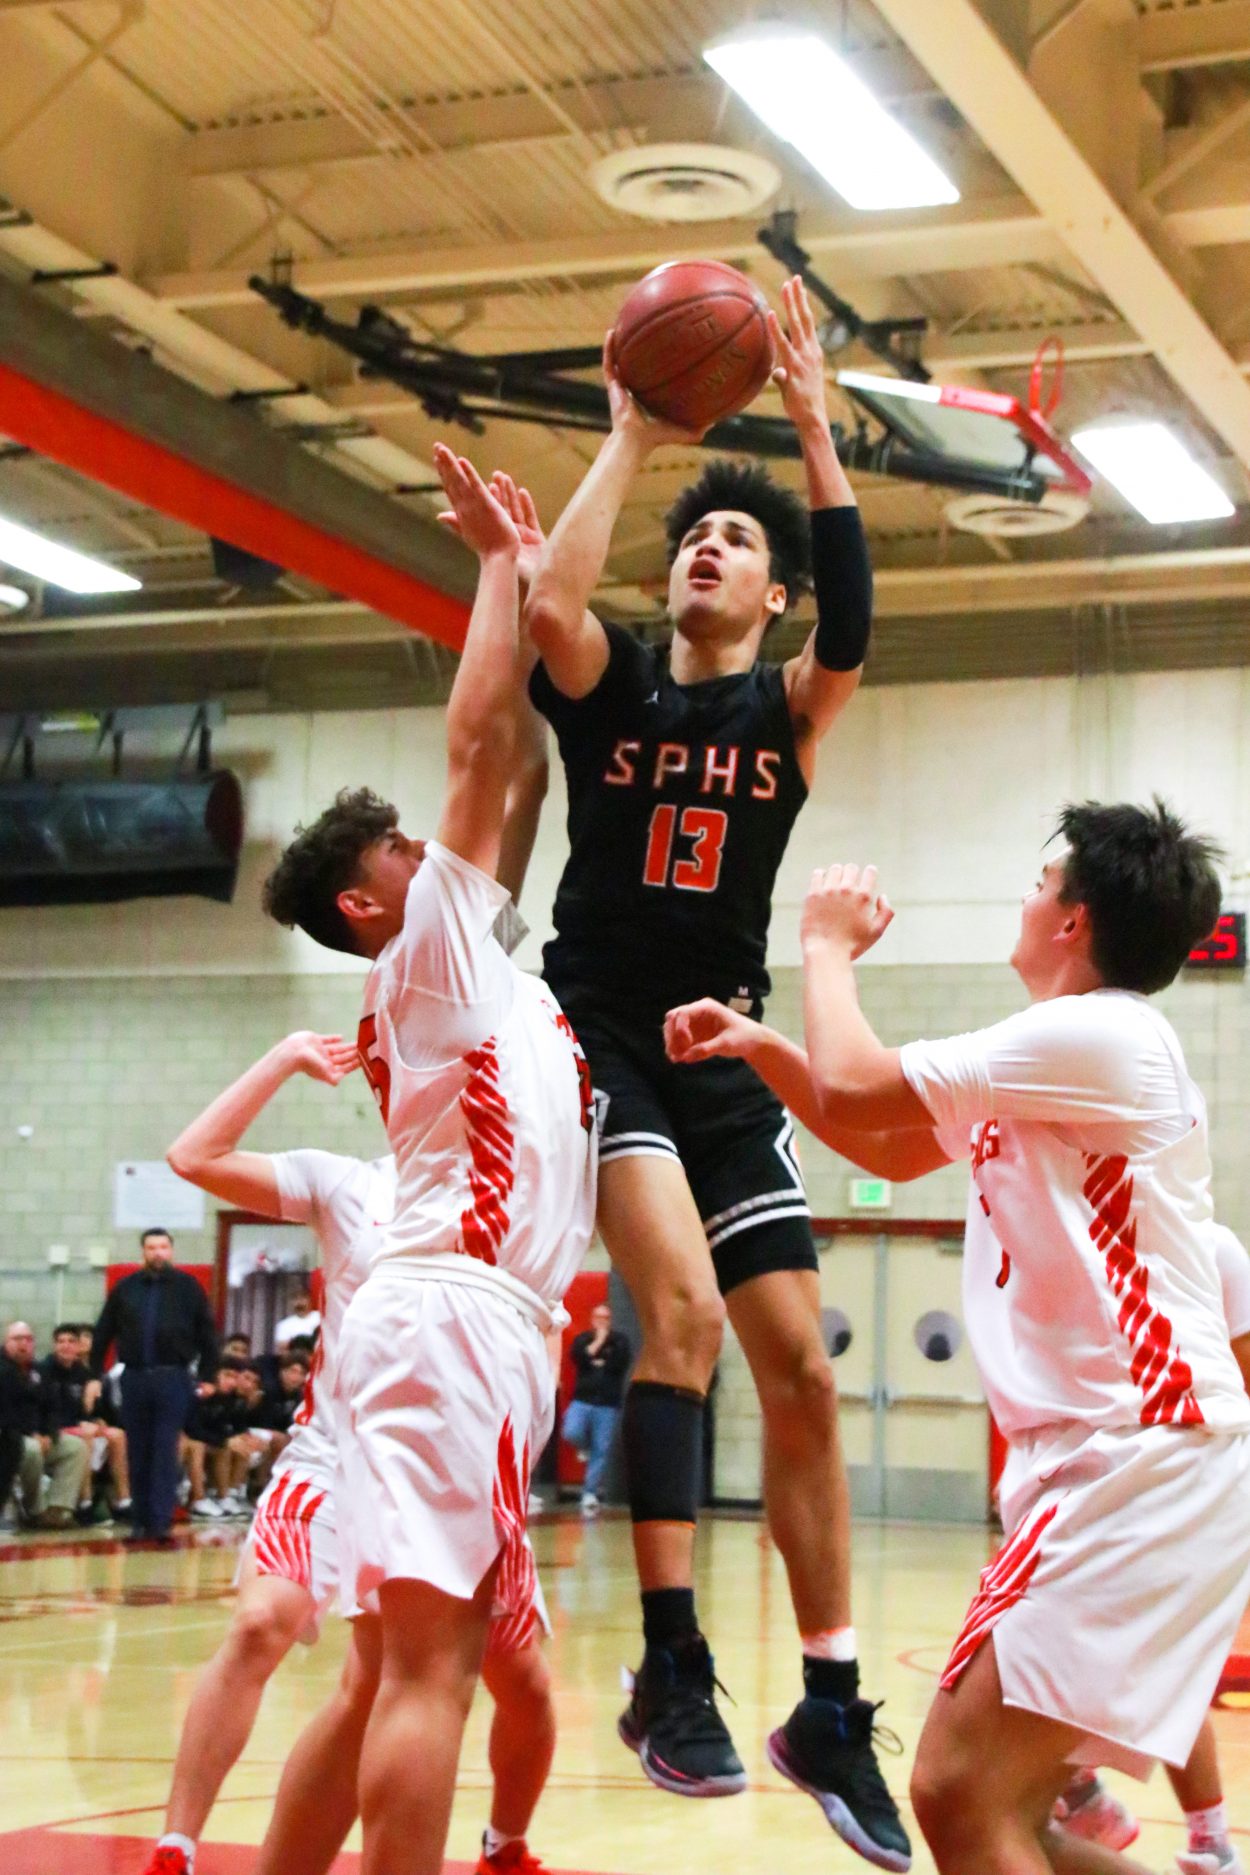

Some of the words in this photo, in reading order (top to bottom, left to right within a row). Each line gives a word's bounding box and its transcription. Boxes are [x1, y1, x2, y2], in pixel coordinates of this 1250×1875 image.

[604, 738, 781, 800] SPHS
[643, 803, 728, 892] 13
[1188, 915, 1238, 960] 5
